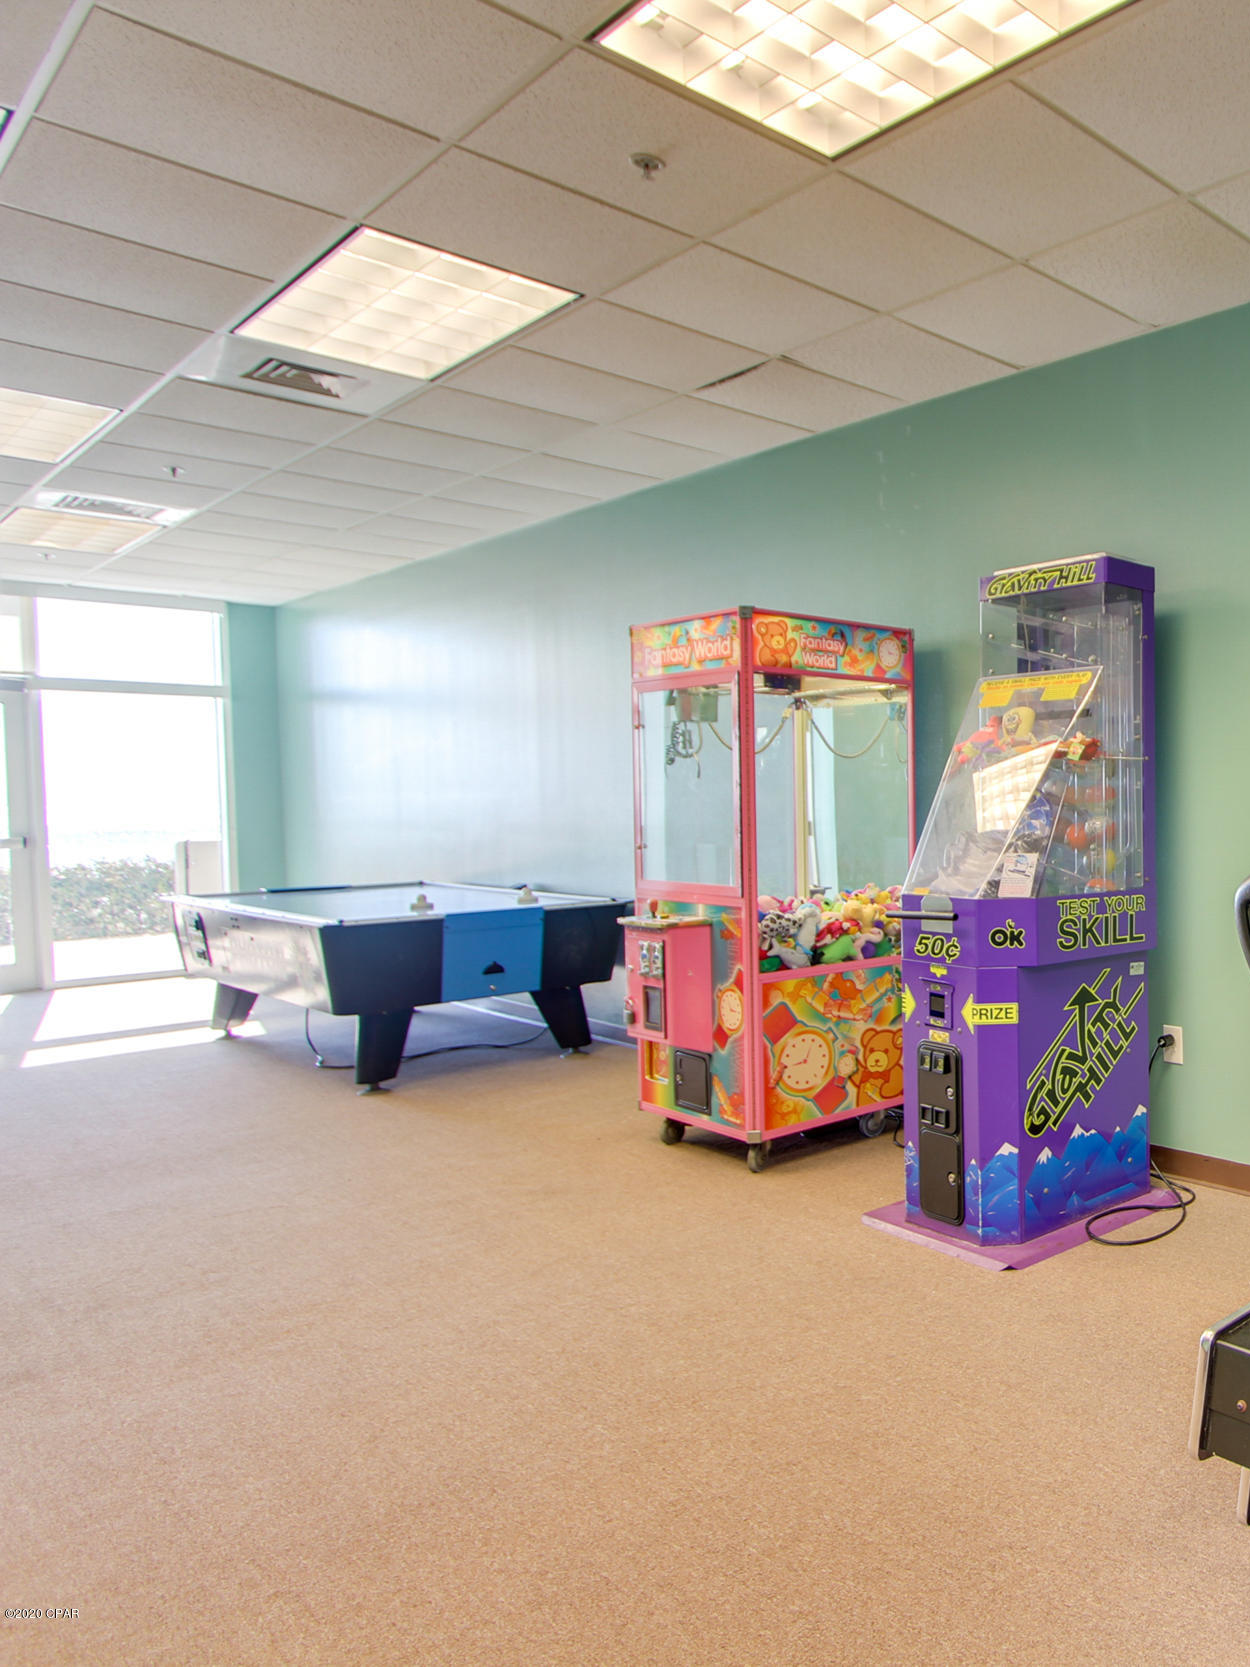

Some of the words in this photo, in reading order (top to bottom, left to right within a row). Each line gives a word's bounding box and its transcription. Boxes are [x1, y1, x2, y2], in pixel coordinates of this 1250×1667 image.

[645, 645, 691, 667] Fantasy
[694, 635, 732, 659] World
[800, 632, 847, 656] Fantasy
[802, 651, 836, 668] World
[1057, 898, 1099, 917] TEST
[1104, 895, 1146, 913] YOUR
[989, 922, 1025, 948] OK
[1057, 912, 1146, 951] SKILL
[915, 933, 960, 963] 50¢
[971, 1007, 1015, 1020] PRIZE
